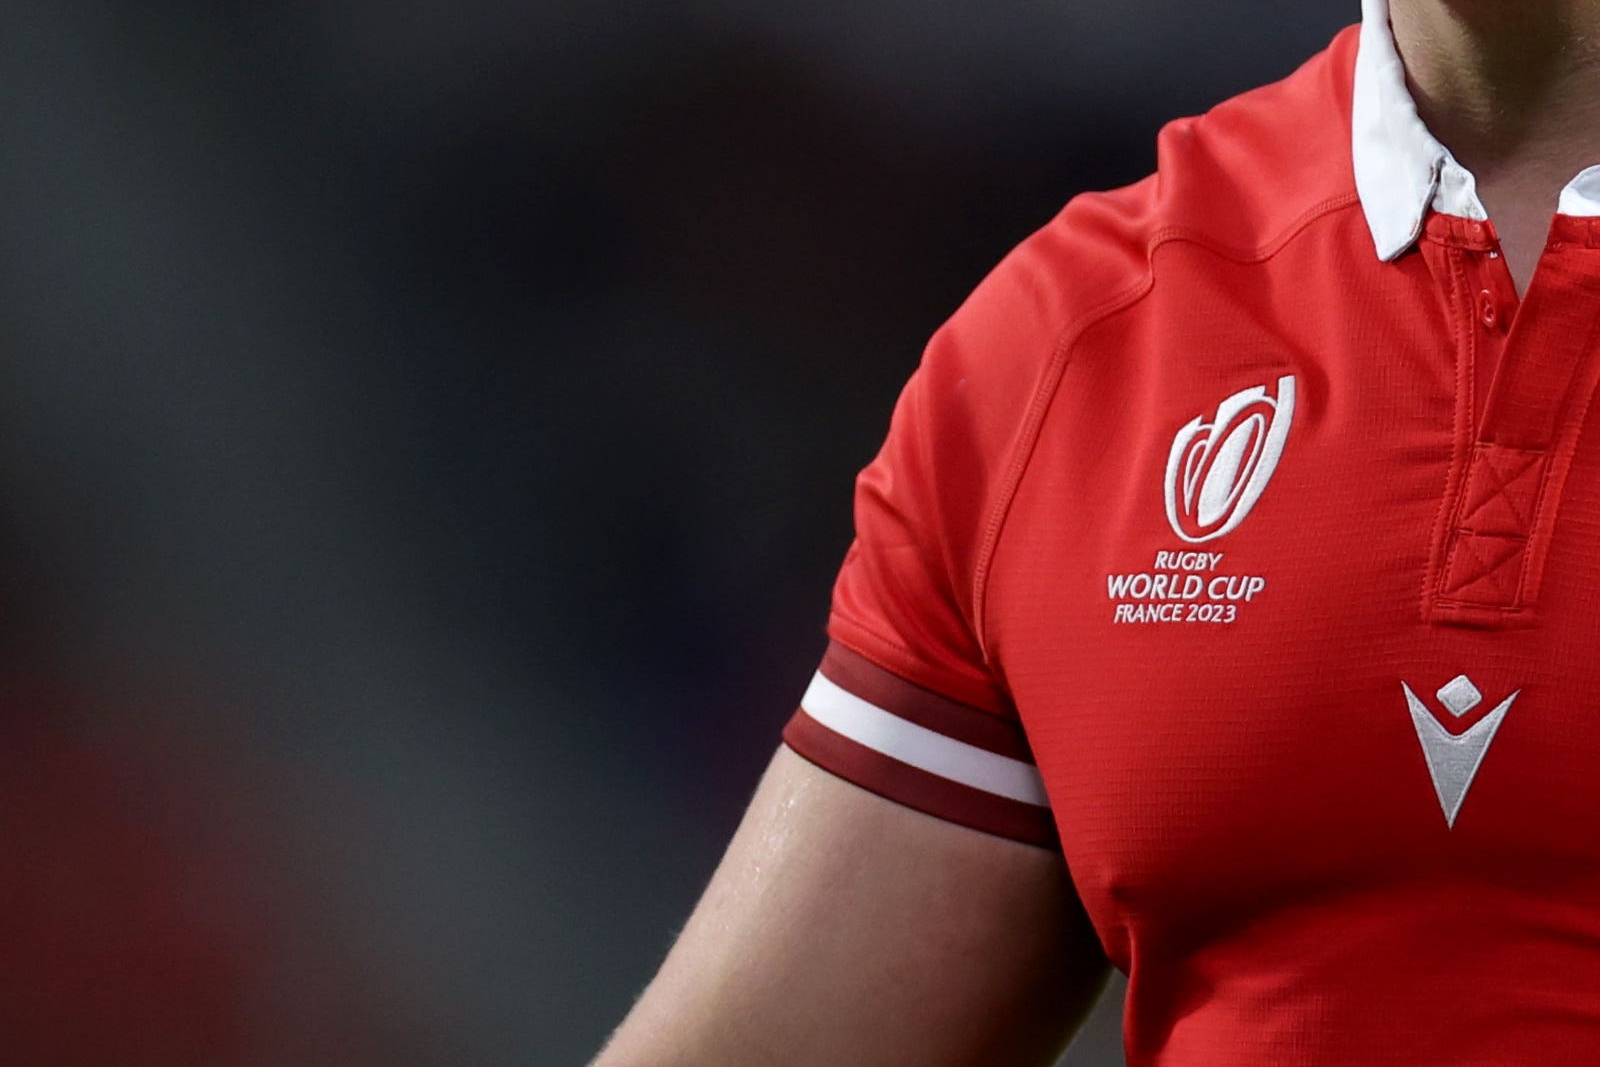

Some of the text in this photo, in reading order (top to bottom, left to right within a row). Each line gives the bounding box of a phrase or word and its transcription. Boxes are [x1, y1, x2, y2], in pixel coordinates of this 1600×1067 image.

[1154, 550, 1224, 571] RUGBY
[1107, 573, 1266, 602] WORLD CUP
[1113, 603, 1237, 624] FRANCE 2023
